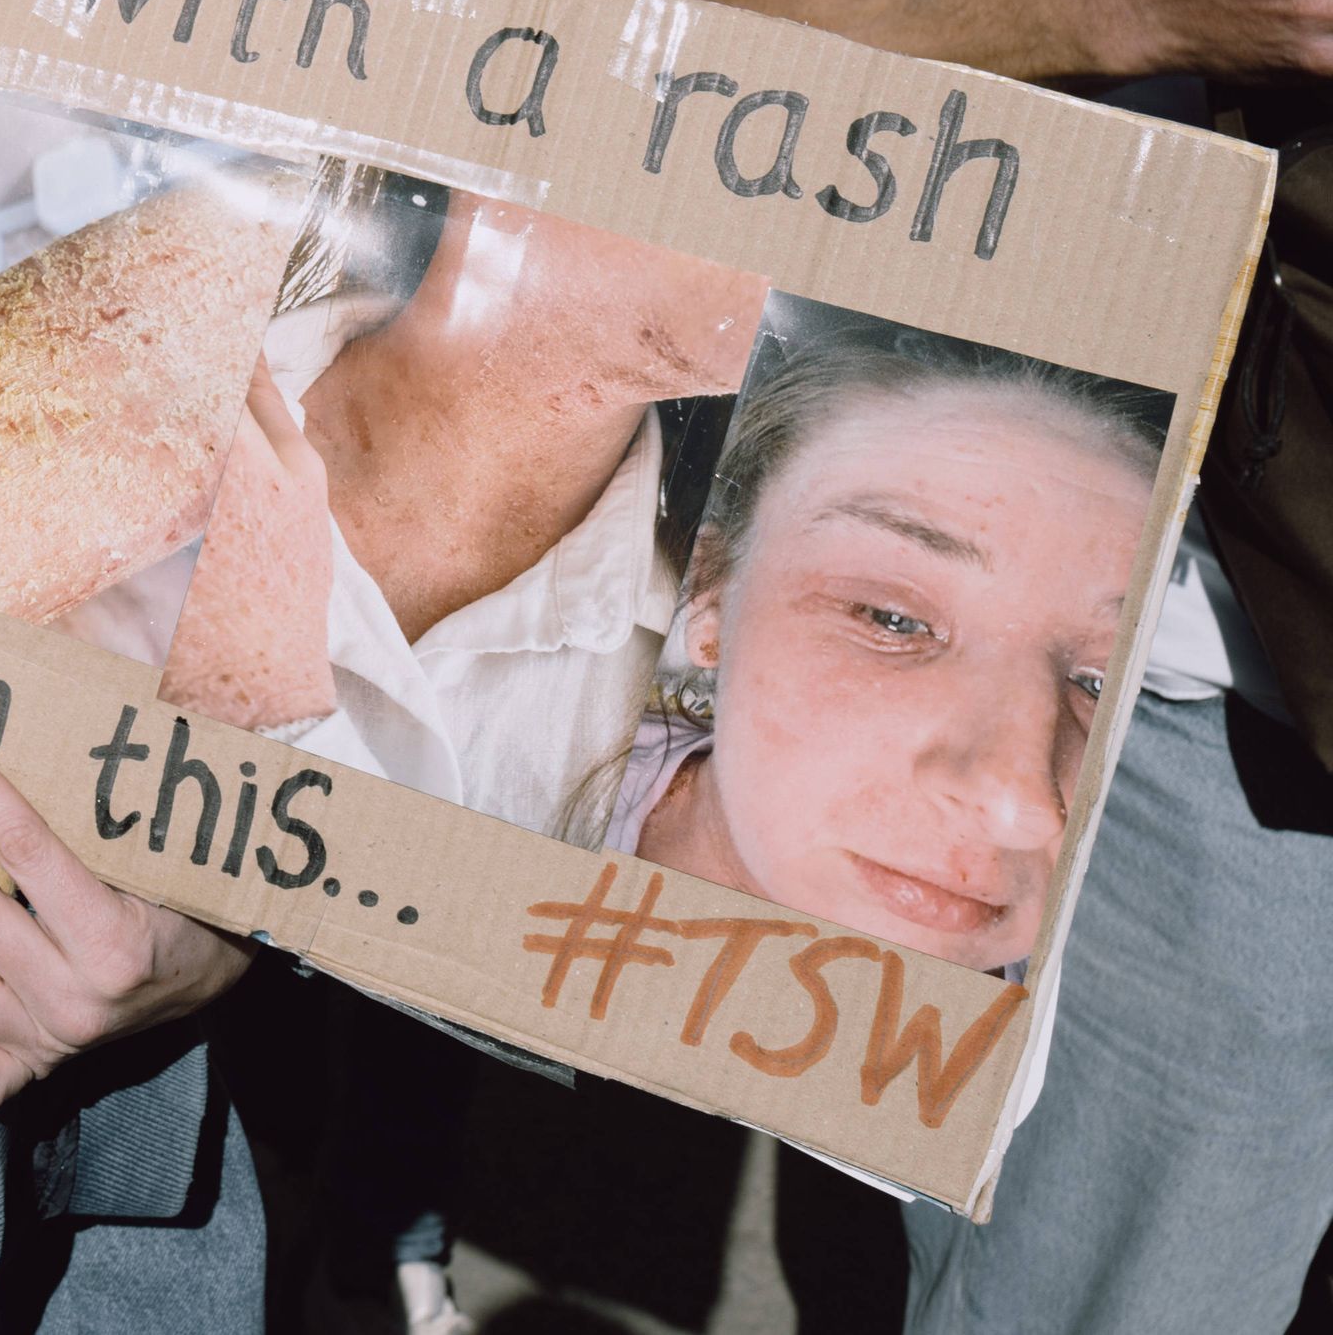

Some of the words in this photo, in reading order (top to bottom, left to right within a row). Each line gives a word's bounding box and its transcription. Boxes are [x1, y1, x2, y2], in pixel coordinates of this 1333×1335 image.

[466, 26, 560, 138] a
[640, 71, 1019, 260] rash
[521, 862, 1031, 1130] #TSW
